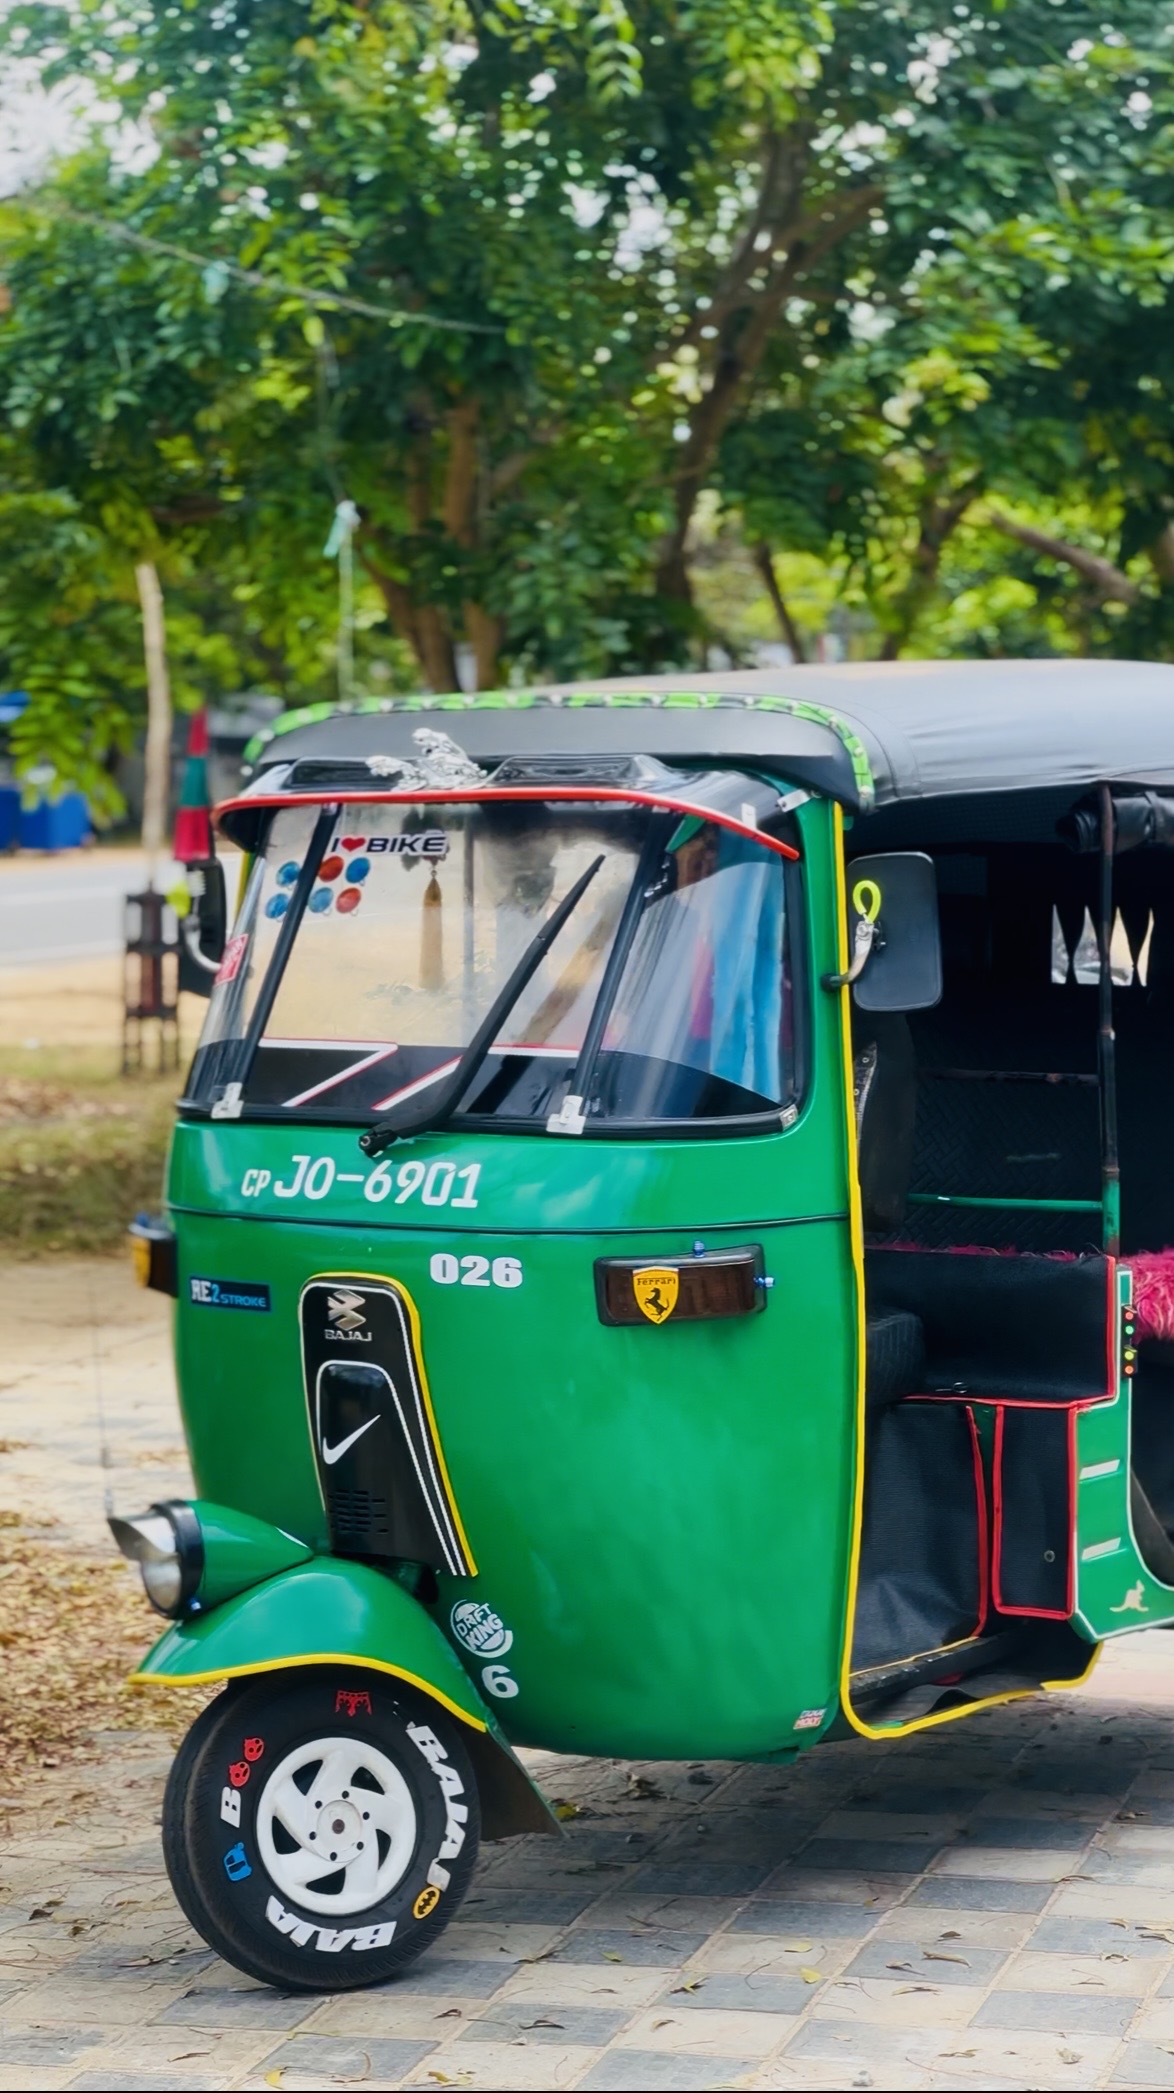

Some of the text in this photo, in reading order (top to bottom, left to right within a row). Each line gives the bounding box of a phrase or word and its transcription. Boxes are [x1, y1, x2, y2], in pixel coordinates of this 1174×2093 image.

[331, 836, 447, 853] I BIKE
[241, 1154, 482, 1209] CP JO-6901
[429, 1252, 523, 1288] 026
[637, 1278, 676, 1286] Ferrari
[220, 1294, 267, 1307] STROKE
[324, 1328, 373, 1342] BAJAJ
[465, 1613, 504, 1651] KING
[481, 1664, 520, 1699] 6
[265, 1894, 398, 1953] BAJA
